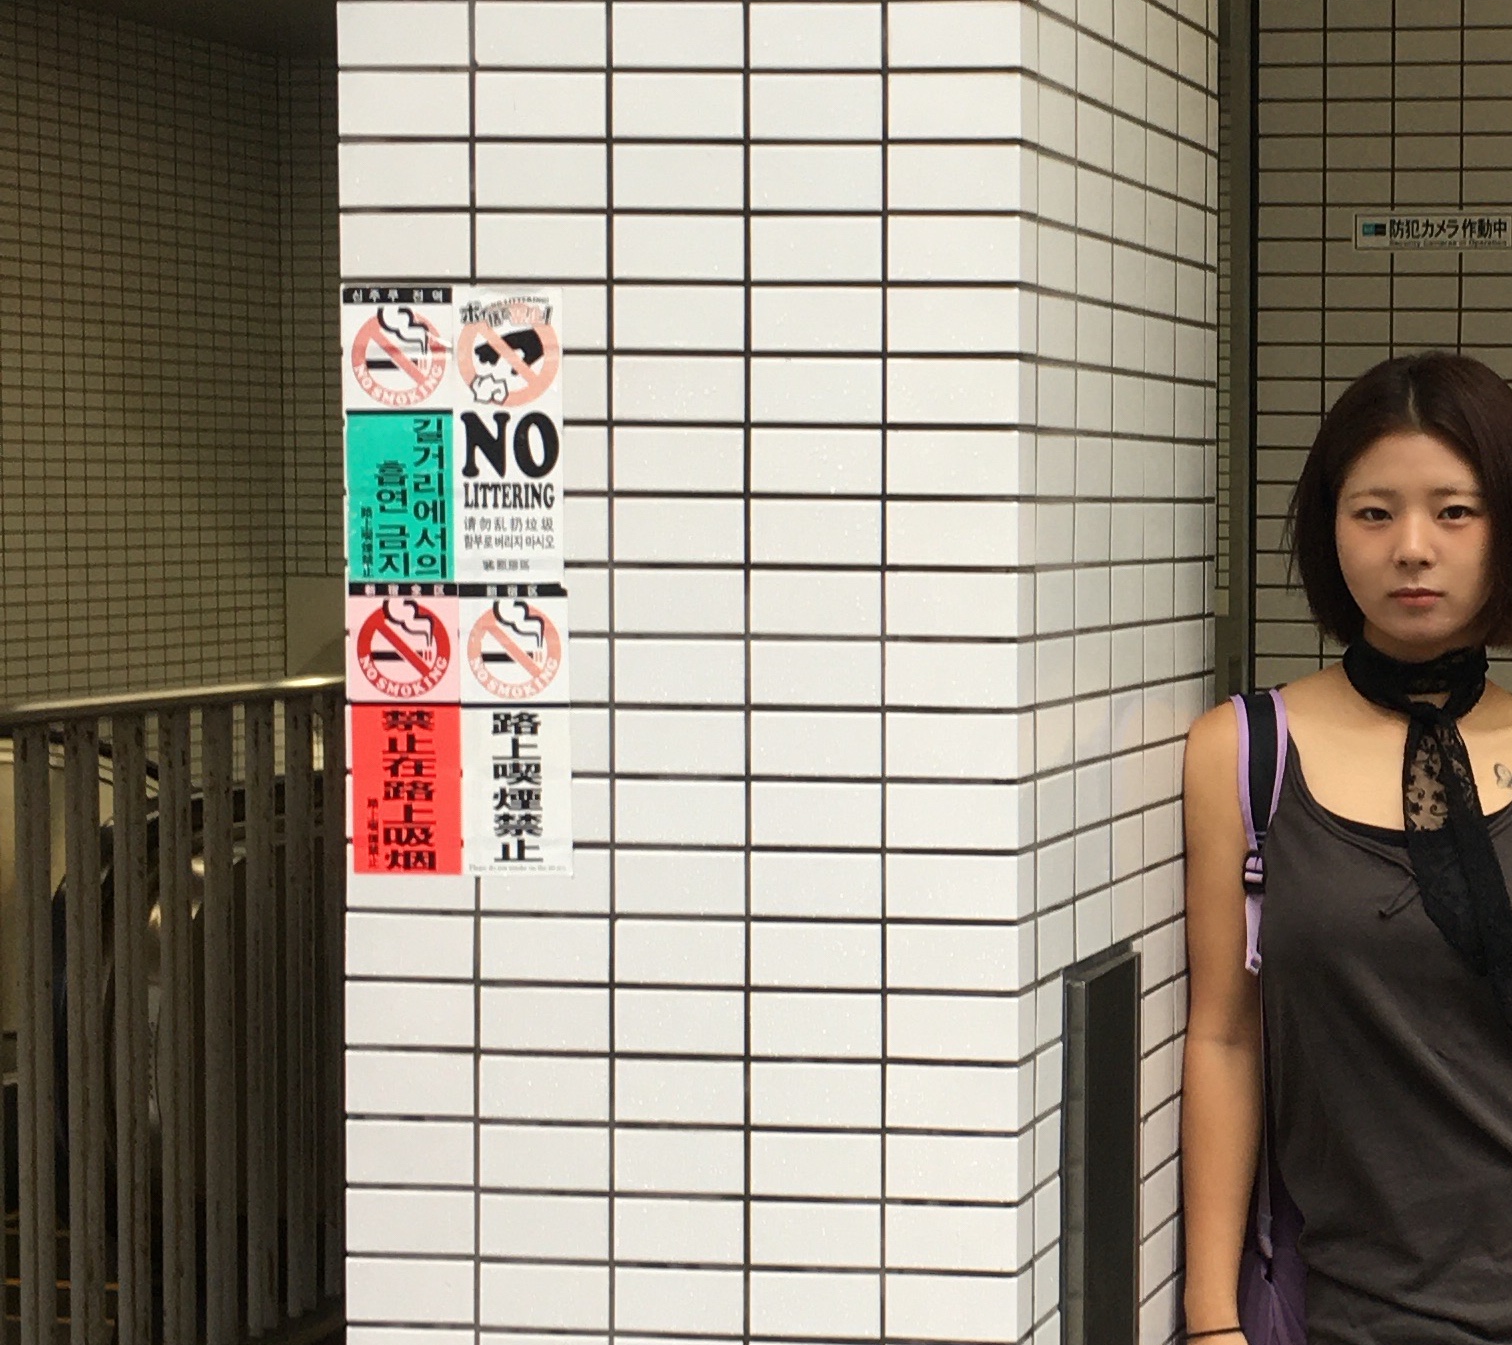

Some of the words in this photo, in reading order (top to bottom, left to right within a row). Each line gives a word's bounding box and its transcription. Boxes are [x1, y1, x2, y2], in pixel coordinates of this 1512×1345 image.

[1389, 218, 1508, 239] 防犯カメラ作動中
[355, 365, 370, 391] NO
[369, 364, 443, 405] SMOKING
[460, 411, 559, 478] NO
[374, 460, 410, 578] 흡연금지
[413, 418, 447, 579] 길거리에서의
[463, 483, 555, 510] LITTERING
[360, 657, 377, 681] NO
[376, 657, 448, 698] SMOKING
[470, 657, 488, 682] NO
[487, 657, 559, 699] SMOKING
[382, 710, 437, 871] 禁止在路上吸烟
[492, 712, 543, 863] 路上喫煙禁止
